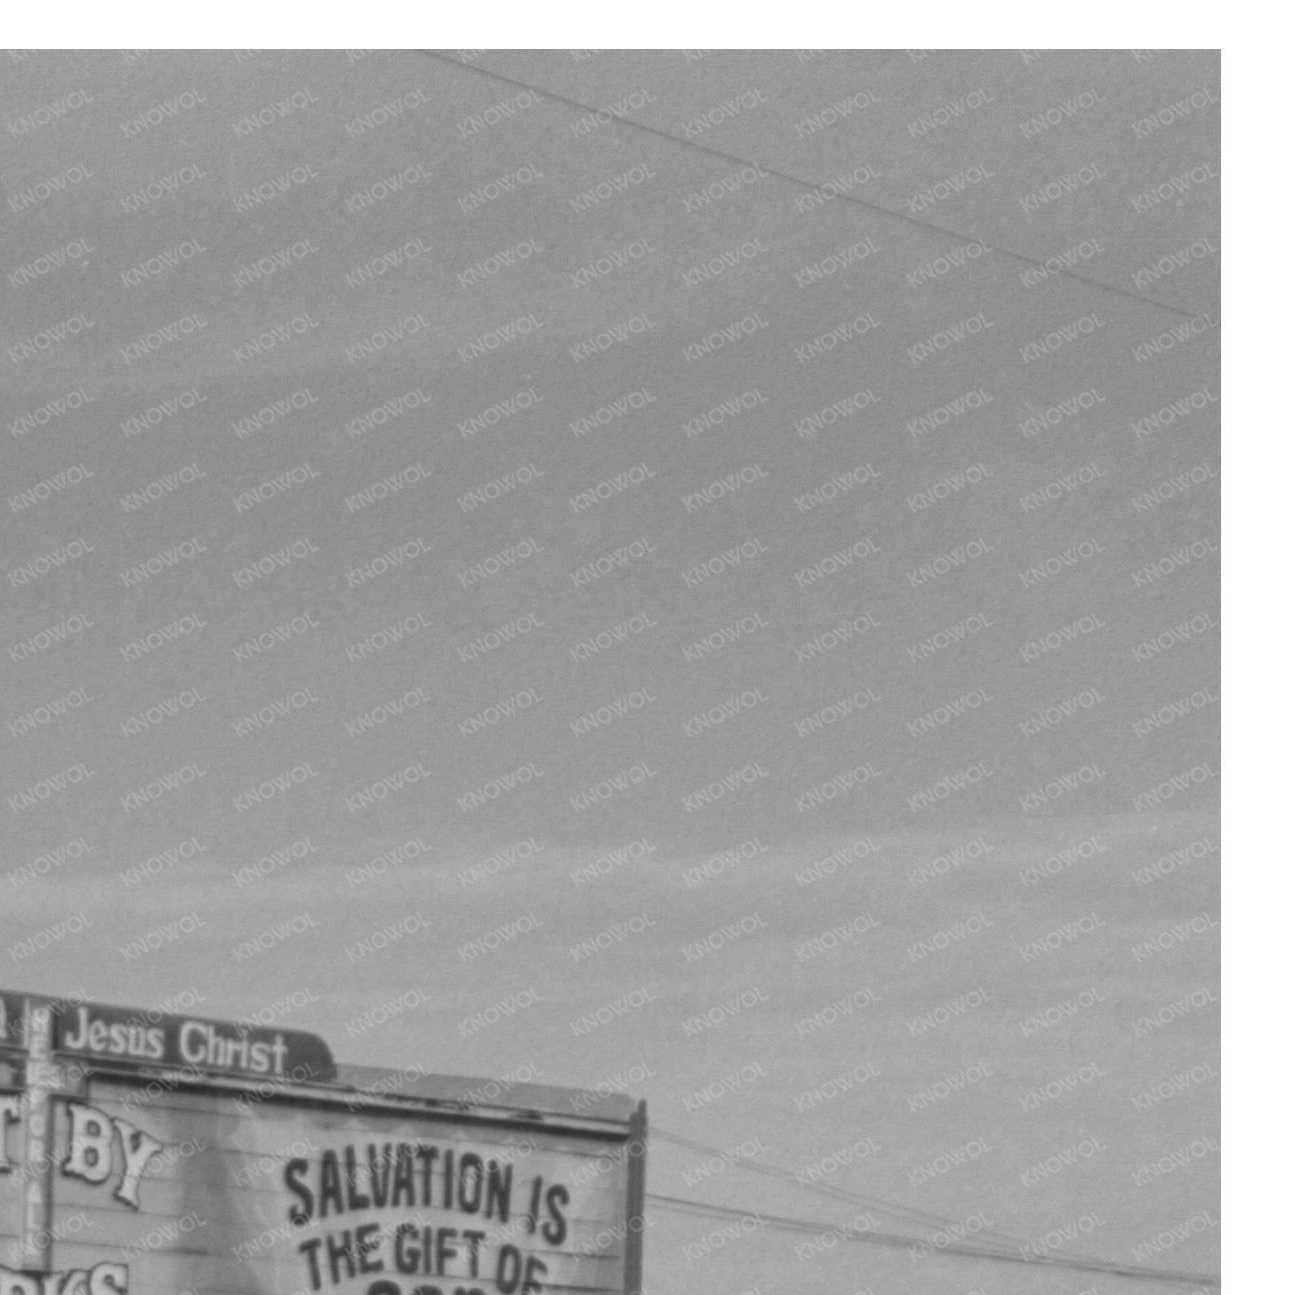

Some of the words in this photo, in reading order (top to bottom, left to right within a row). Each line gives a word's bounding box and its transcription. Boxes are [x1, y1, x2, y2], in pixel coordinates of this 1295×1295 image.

[65, 1006, 165, 1060] Jesus
[179, 1021, 288, 1074] Christ
[60, 1098, 162, 1213] BY
[284, 1142, 513, 1226] SALVATION
[526, 1175, 570, 1246] IS
[299, 1222, 384, 1291] THE
[394, 1223, 486, 1279] GIFT
